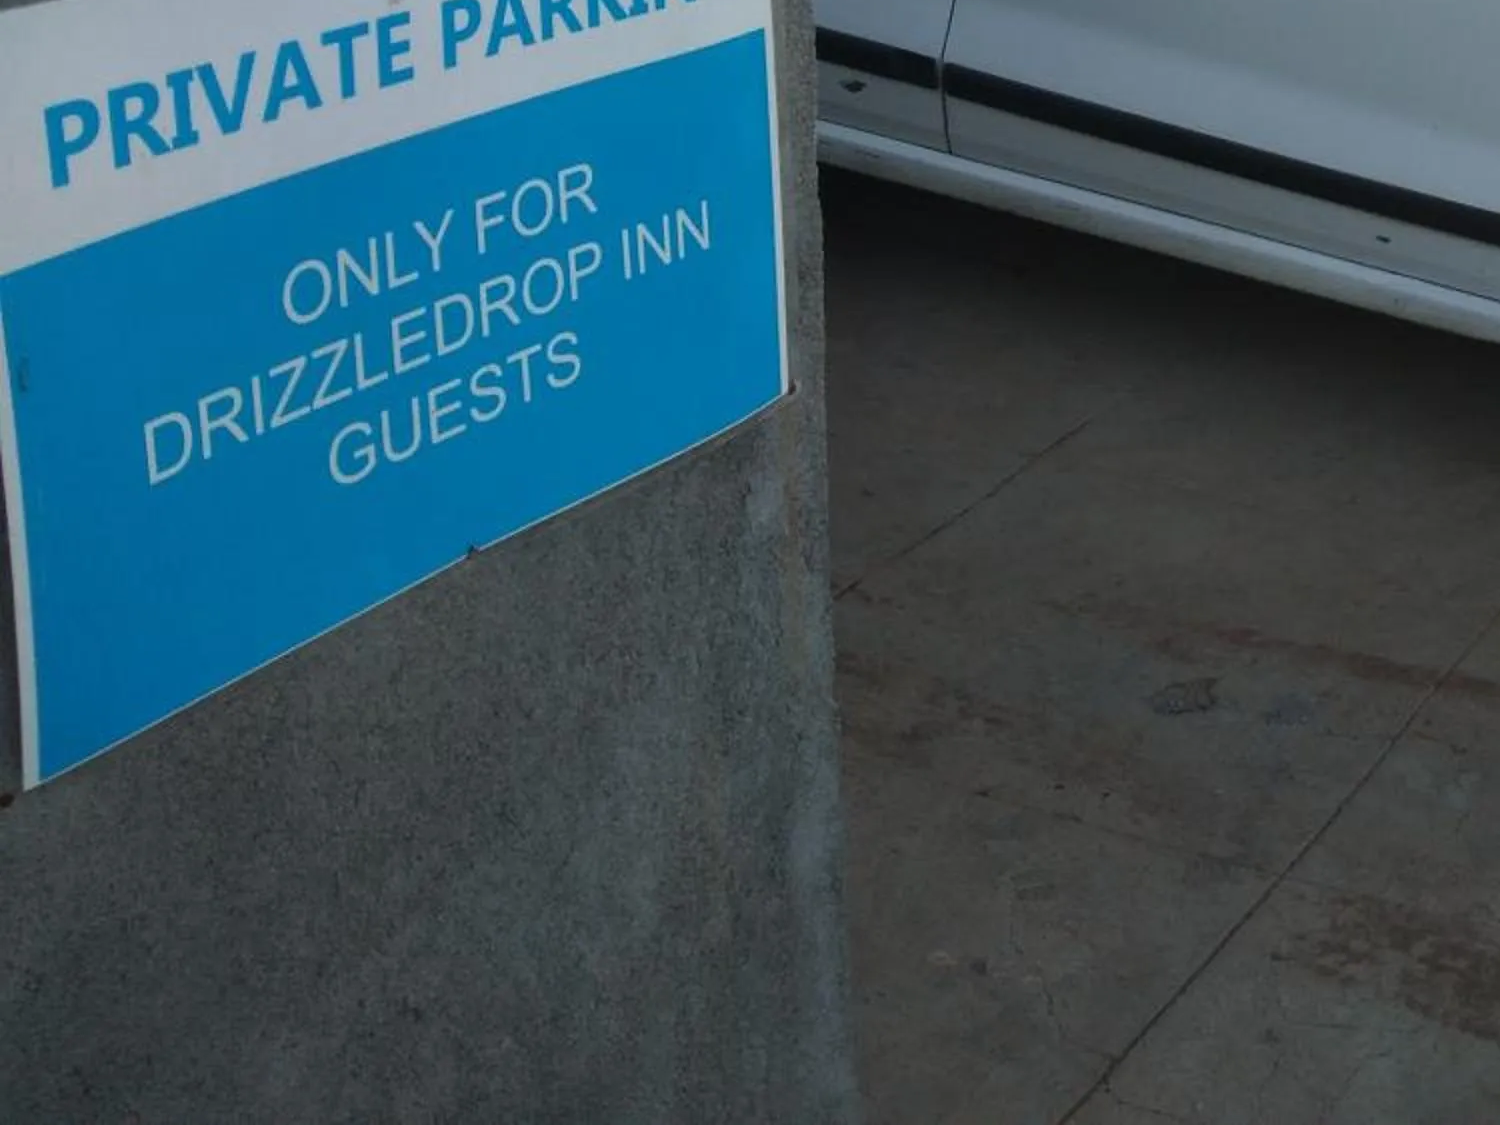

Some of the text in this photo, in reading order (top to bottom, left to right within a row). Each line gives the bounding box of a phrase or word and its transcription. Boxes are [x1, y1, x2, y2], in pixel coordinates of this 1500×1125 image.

[44, 11, 414, 188] PRIVATE
[283, 163, 597, 324] ONLY FOR
[143, 201, 711, 486] DRIZZLEDROP INN
[329, 332, 582, 485] GUESTS
